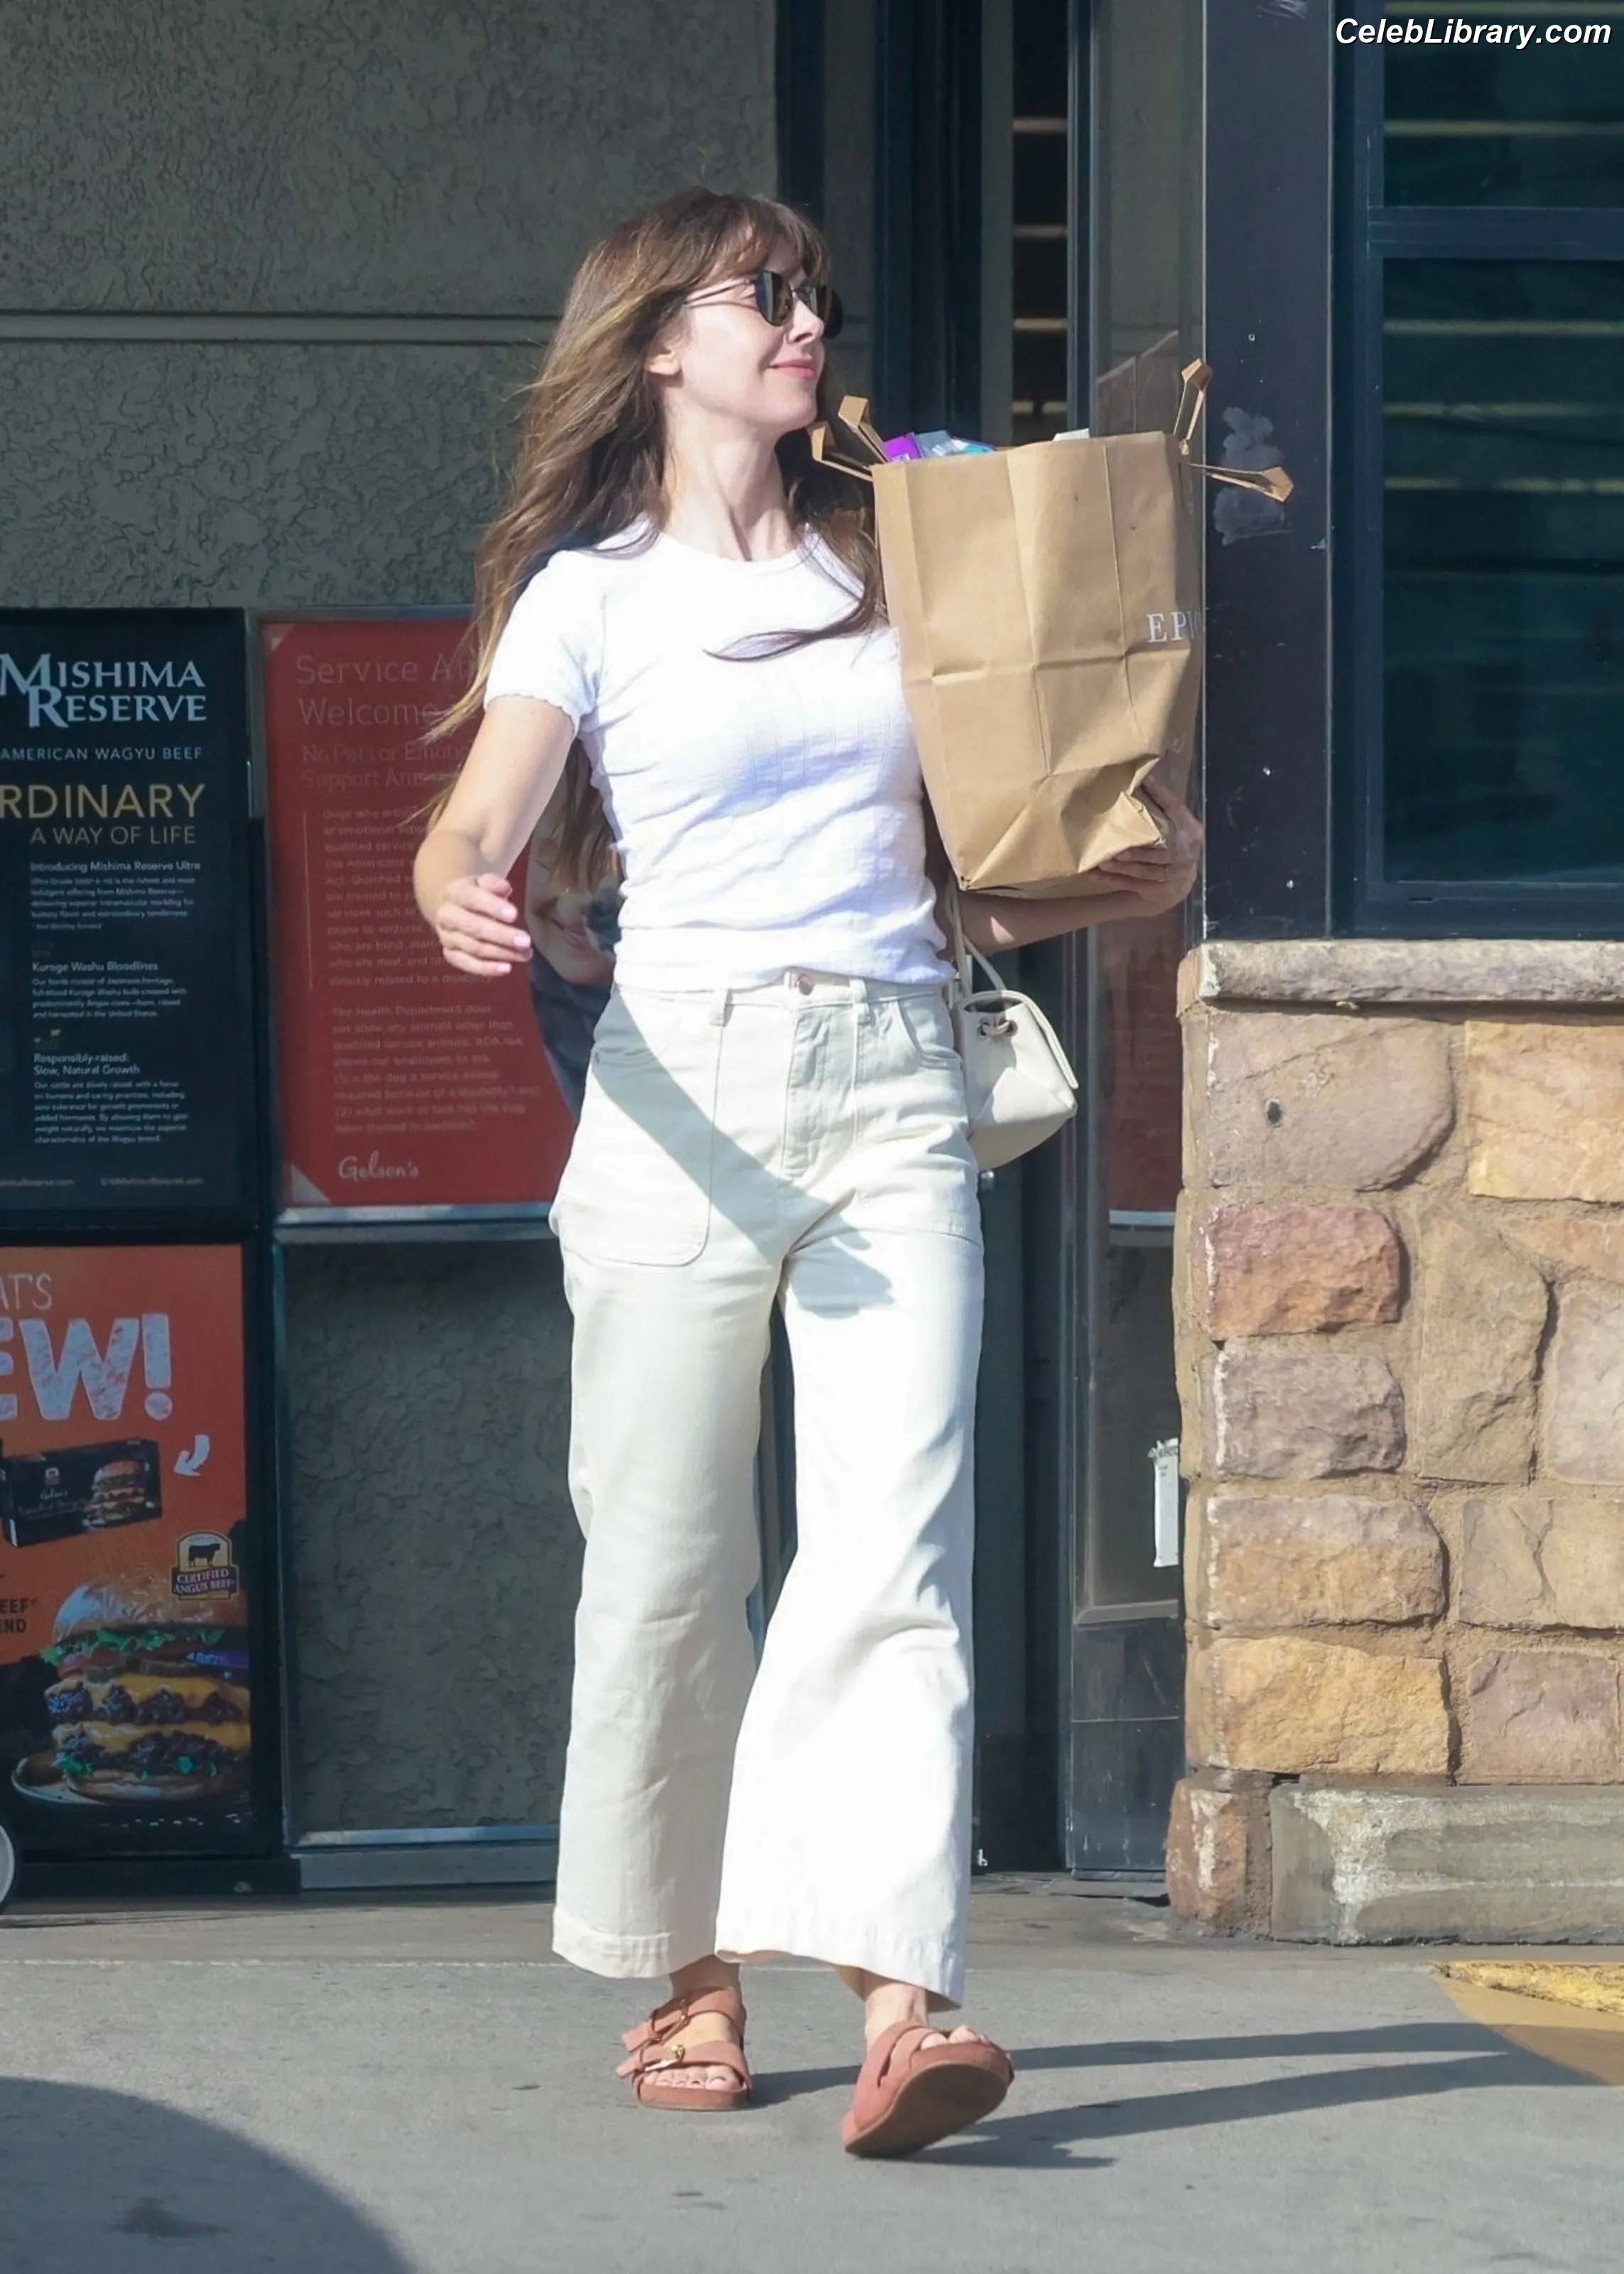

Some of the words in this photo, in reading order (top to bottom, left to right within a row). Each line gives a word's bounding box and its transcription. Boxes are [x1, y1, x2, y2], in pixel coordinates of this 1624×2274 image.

[0, 653, 205, 696] MISHIMA
[296, 654, 418, 684] Service
[28, 685, 207, 728] RESERVE
[1, 748, 88, 760] AMERICAN
[95, 748, 155, 760] WAGYU
[163, 747, 202, 760] BEEF
[303, 770, 381, 793] Support
[30, 826, 46, 844] A
[53, 826, 103, 844] WAY
[110, 826, 141, 844] OF
[150, 826, 196, 844] LIFE
[63, 1065, 100, 1075] Natural
[102, 1064, 141, 1075] Growth
[0, 1618, 27, 1635] ND
